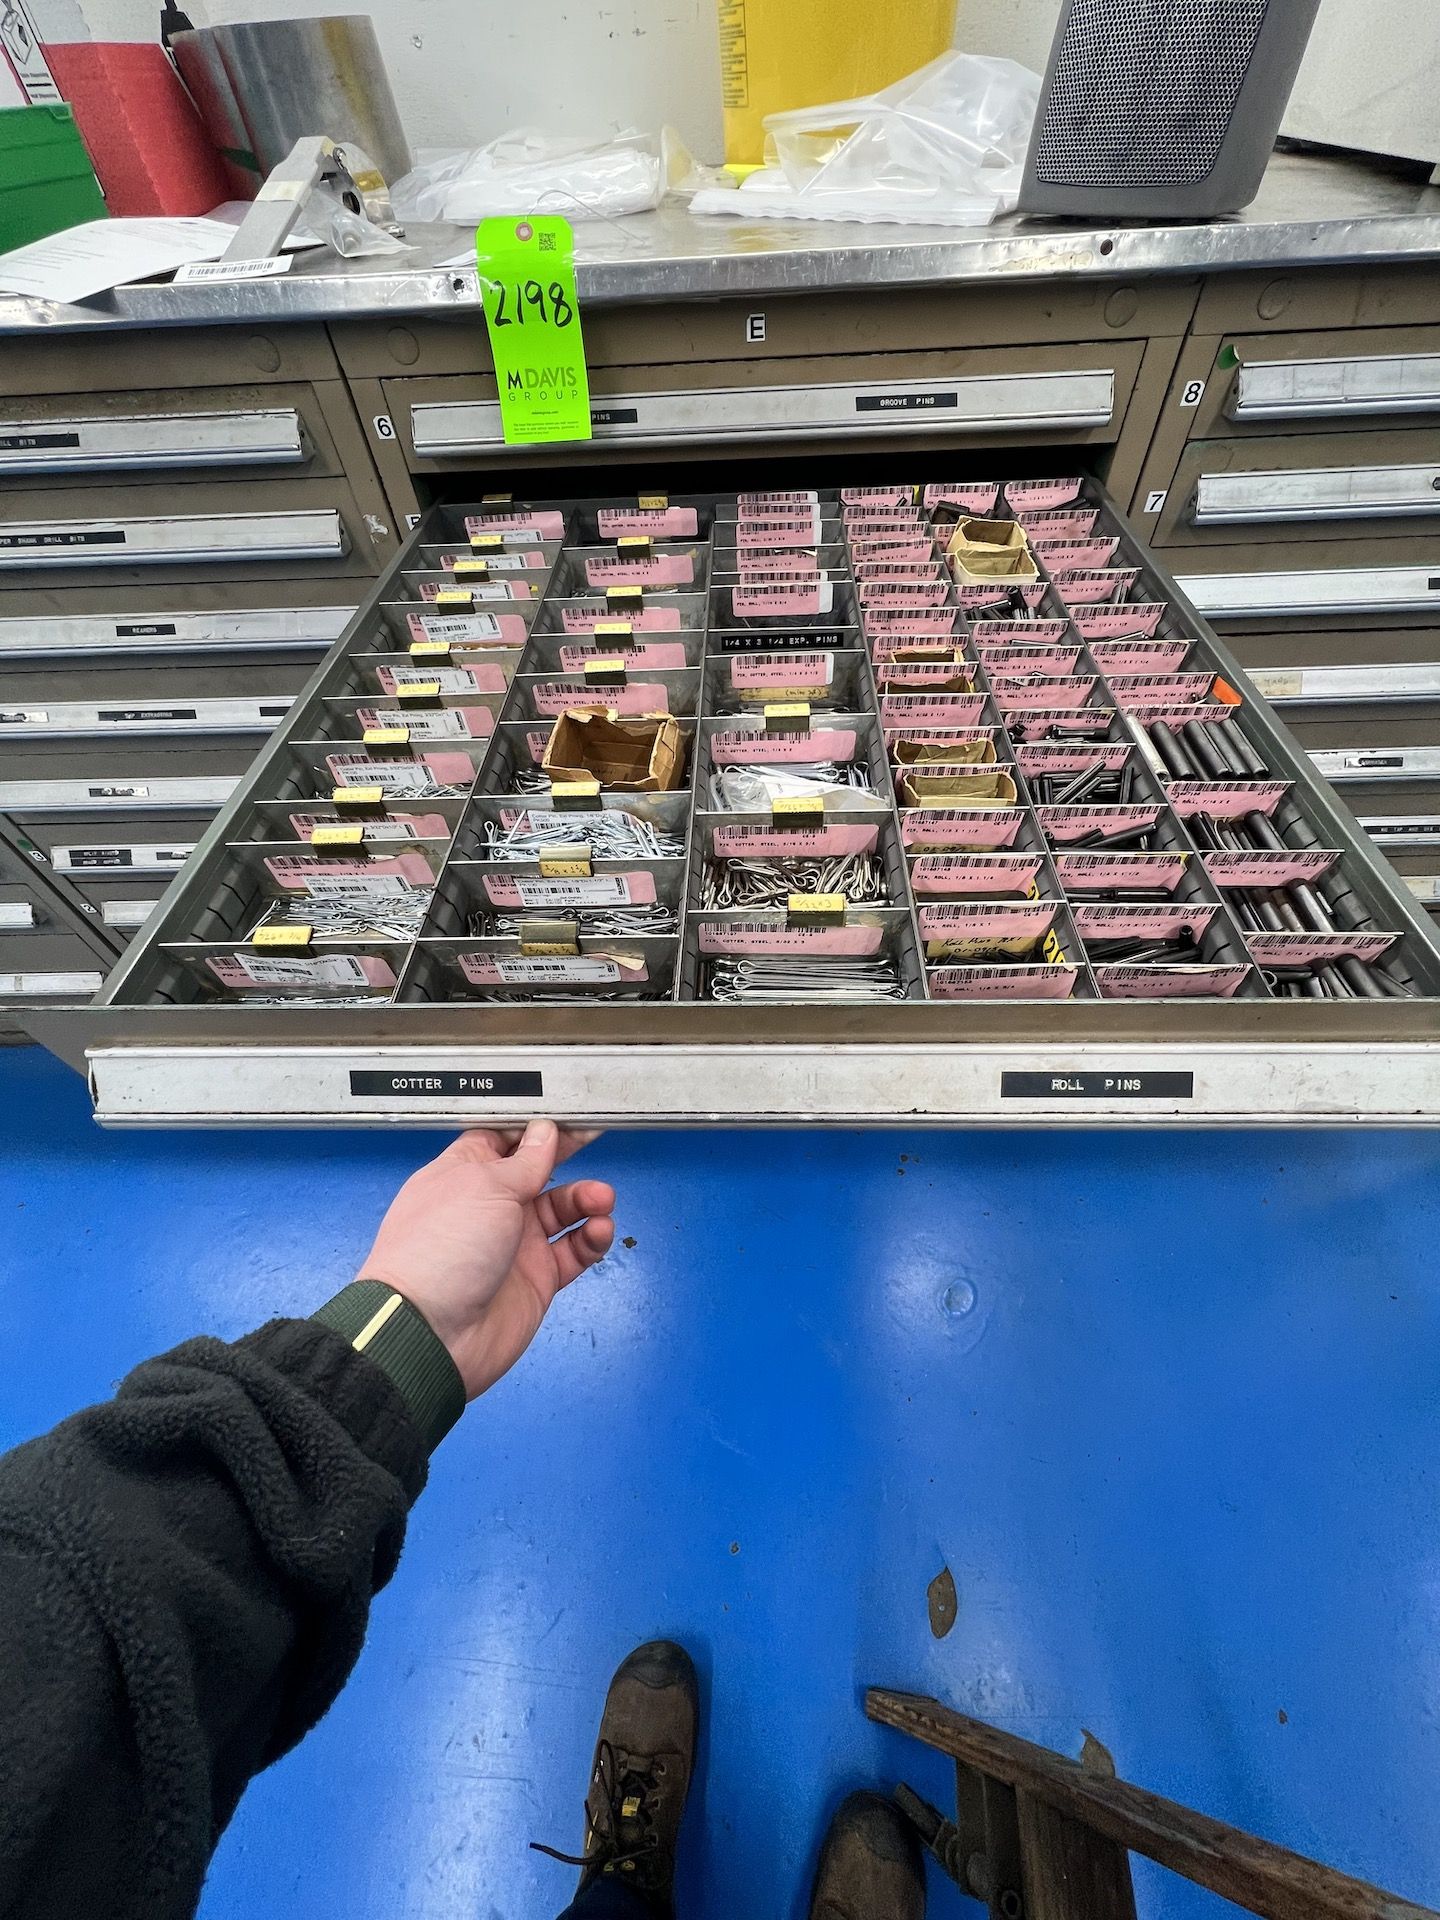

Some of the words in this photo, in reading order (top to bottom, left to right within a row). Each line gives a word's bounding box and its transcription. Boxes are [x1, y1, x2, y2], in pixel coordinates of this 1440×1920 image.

[490, 280, 573, 328] 2198
[750, 316, 764, 339] E
[508, 370, 523, 390] M
[524, 366, 577, 389] DAVIS
[508, 389, 578, 402] GROUP
[1184, 382, 1201, 404] 8
[879, 398, 908, 407] GROOVE
[915, 396, 935, 405] PINS
[591, 413, 611, 421] PINS
[377, 417, 392, 437] 6
[1149, 494, 1164, 511] 7
[789, 637, 810, 645] EXP.
[816, 636, 838, 644] PINS
[391, 1078, 442, 1089] COTTER
[459, 1078, 494, 1089] PINS
[1051, 1079, 1084, 1091] ROLL
[1104, 1079, 1142, 1091] PINS
